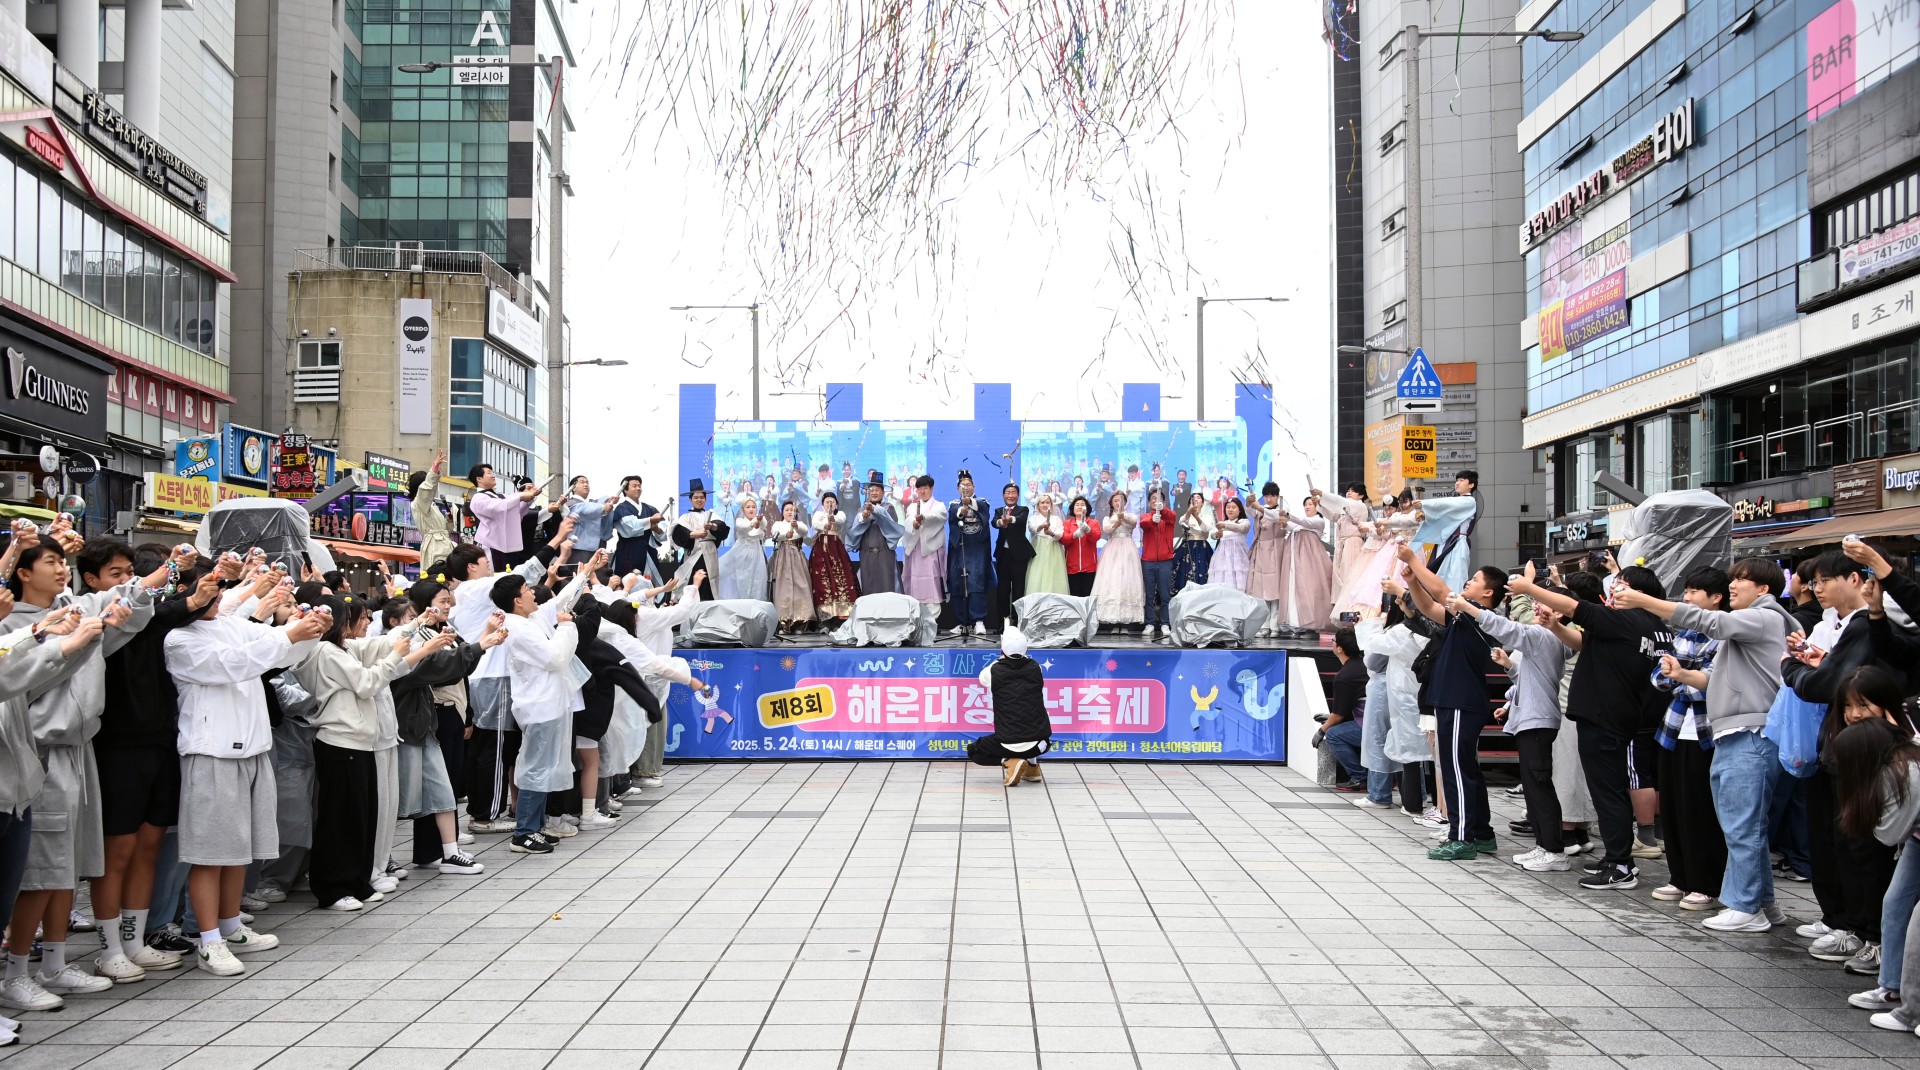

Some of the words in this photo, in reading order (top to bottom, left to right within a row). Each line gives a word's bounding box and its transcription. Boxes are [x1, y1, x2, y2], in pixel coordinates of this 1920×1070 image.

[470, 10, 506, 48] A
[1812, 34, 1852, 82] BAR
[459, 71, 504, 83] 엘리시아
[1653, 97, 1696, 164] 타이
[1874, 233, 1920, 262] 741-700
[1540, 306, 1564, 356] 임대
[1565, 309, 1626, 347] 010-2860-0424
[26, 365, 89, 415] GUINNESS
[1403, 388, 1435, 396] 횡단보도
[284, 435, 307, 448] 정통
[1406, 440, 1431, 450] CCTV
[282, 453, 307, 467] 王家
[276, 471, 315, 489] 탕후루
[1885, 467, 1920, 491] Burge
[157, 478, 211, 509] 스트레스해소
[1566, 522, 1588, 541] GS25
[769, 692, 823, 720] 제8회
[731, 739, 761, 751] 2025.
[763, 736, 776, 751] 5.
[821, 739, 843, 751] 14시
[854, 739, 884, 751] 해운대
[886, 739, 916, 751] 스퀘어
[927, 739, 959, 752] 성년의
[1062, 740, 1083, 752] 공연
[1085, 740, 1127, 752] 경연대회
[1139, 741, 1223, 754] 청소년어울림마당
[122, 915, 137, 941] GOAL
